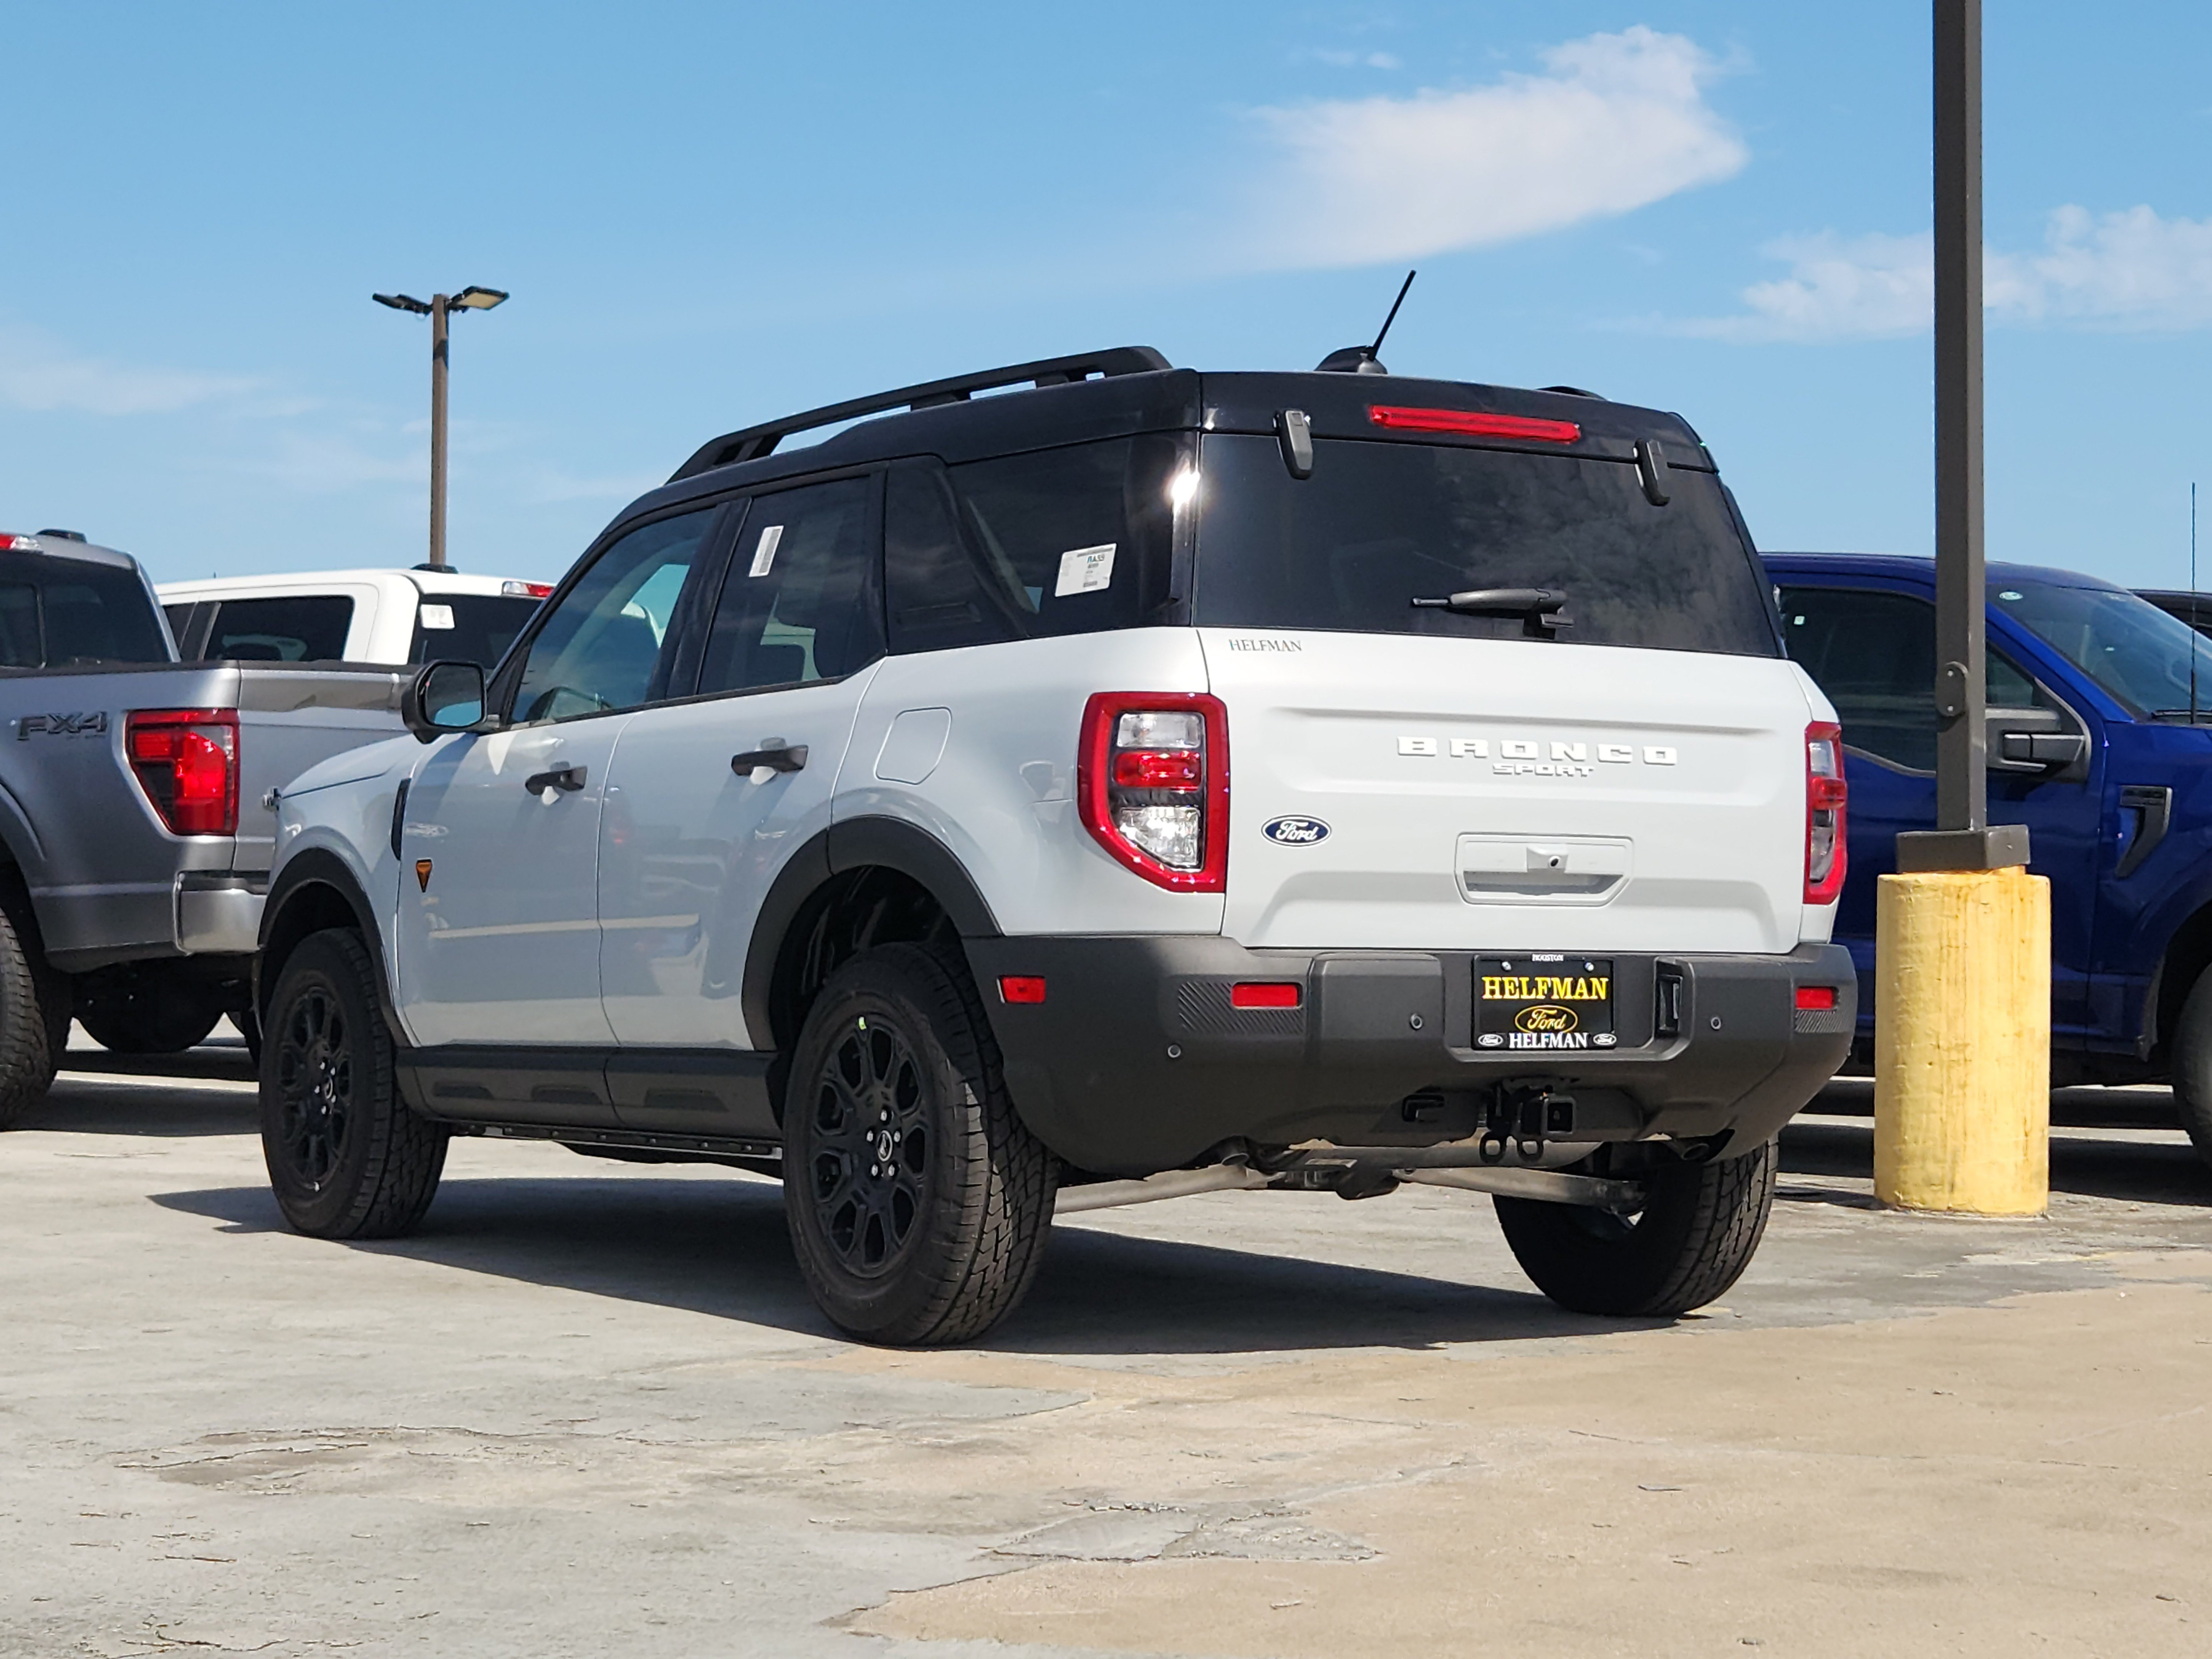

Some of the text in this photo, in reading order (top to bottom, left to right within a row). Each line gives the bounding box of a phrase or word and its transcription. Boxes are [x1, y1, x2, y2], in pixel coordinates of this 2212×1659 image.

[1229, 639, 1302, 652] HELFMAN
[17, 711, 108, 741] FX4
[1397, 736, 1677, 766] BRONCO
[1492, 763, 1594, 777] SPORT
[1276, 820, 1319, 841] Ford
[1481, 977, 1609, 1000] HELFMAN
[1527, 1008, 1567, 1030] Ford
[1509, 1032, 1589, 1049] HELFMAN
